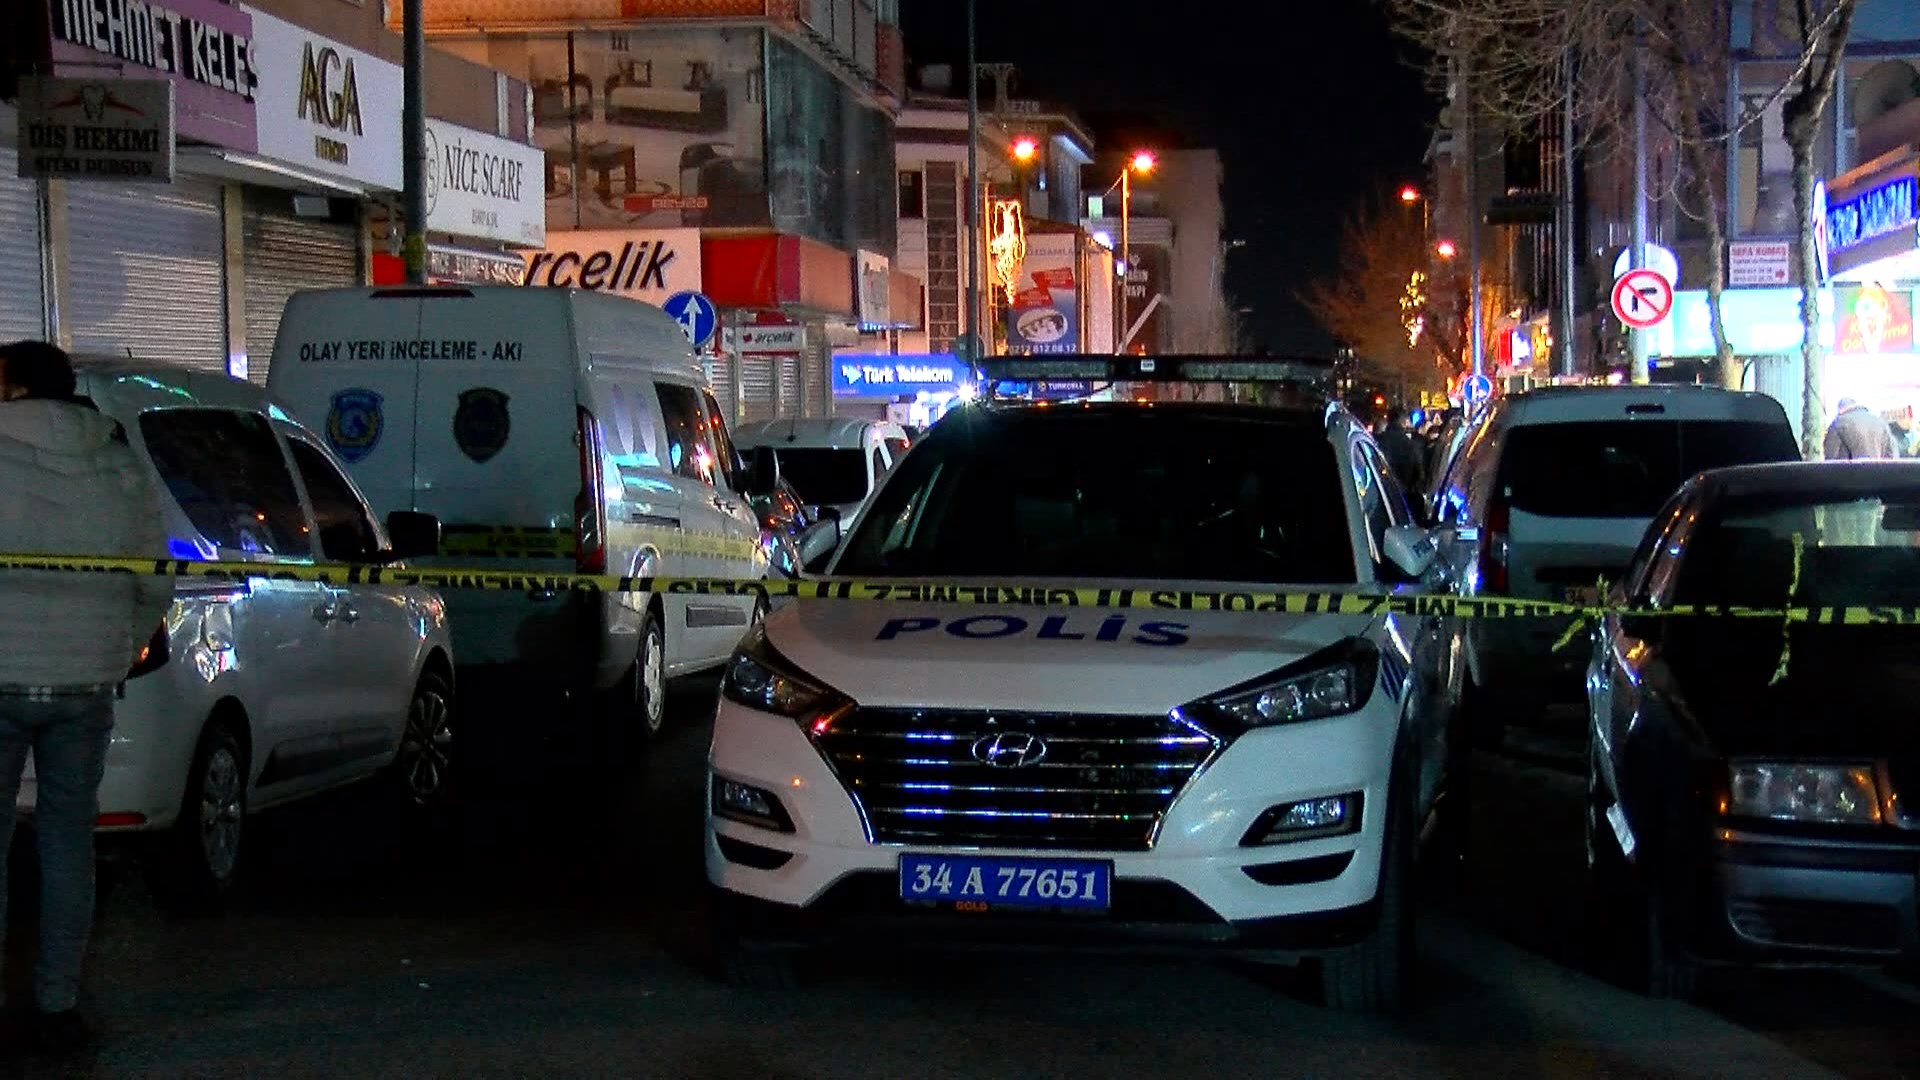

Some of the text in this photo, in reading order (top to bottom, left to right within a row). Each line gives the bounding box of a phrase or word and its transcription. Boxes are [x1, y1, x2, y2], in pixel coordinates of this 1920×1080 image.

[298, 41, 364, 136] AGA
[443, 138, 522, 202] NİCE SCARF
[300, 342, 341, 362] OLAY
[863, 364, 953, 384] Türk Telekom
[875, 613, 1190, 646] POLİS
[911, 864, 1097, 900] 34 A 77651
